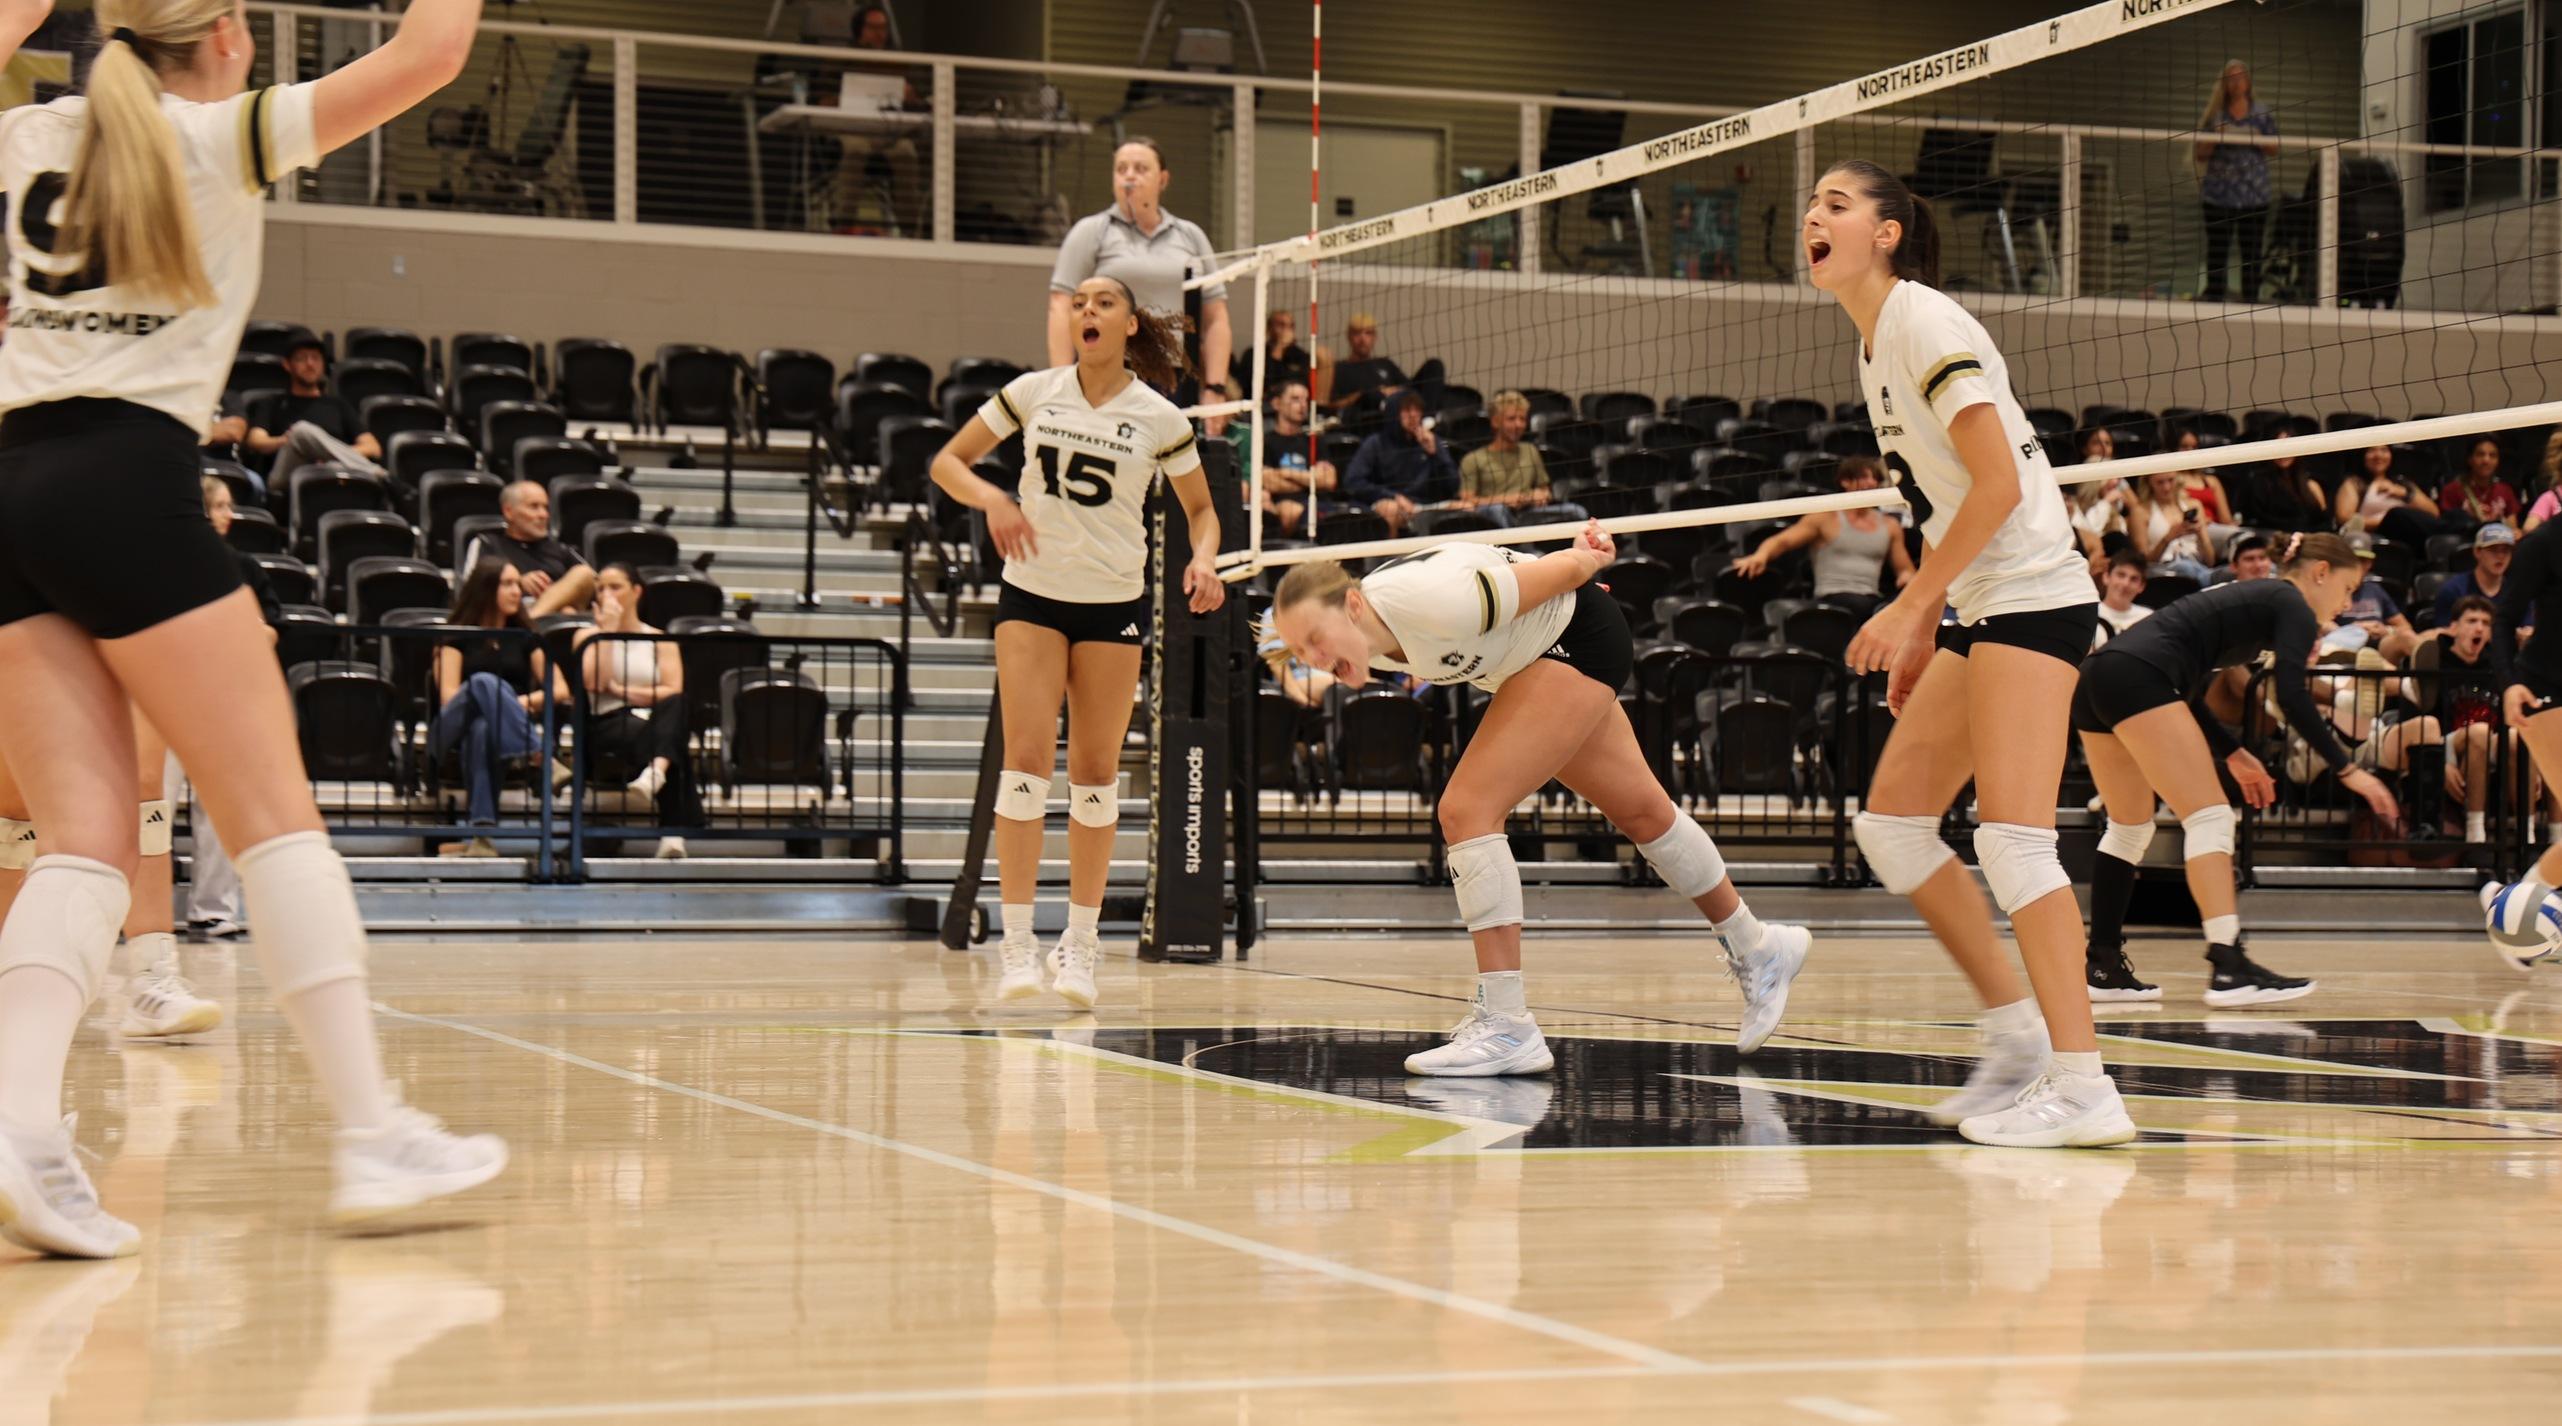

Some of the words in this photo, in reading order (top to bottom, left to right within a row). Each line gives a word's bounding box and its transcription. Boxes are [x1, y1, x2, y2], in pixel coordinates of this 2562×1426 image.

[1856, 43, 1990, 101] NORTHEASTERN
[1644, 116, 1751, 162] NORTHEASTERN
[1467, 172, 1558, 211] NORTHEASTERN
[1319, 217, 1395, 250] NORTHEASTERN
[1036, 424, 1134, 455] NORTHEASTERN
[1035, 443, 1117, 507] 15
[1185, 746, 1204, 803] sports
[1184, 804, 1202, 874] imports
